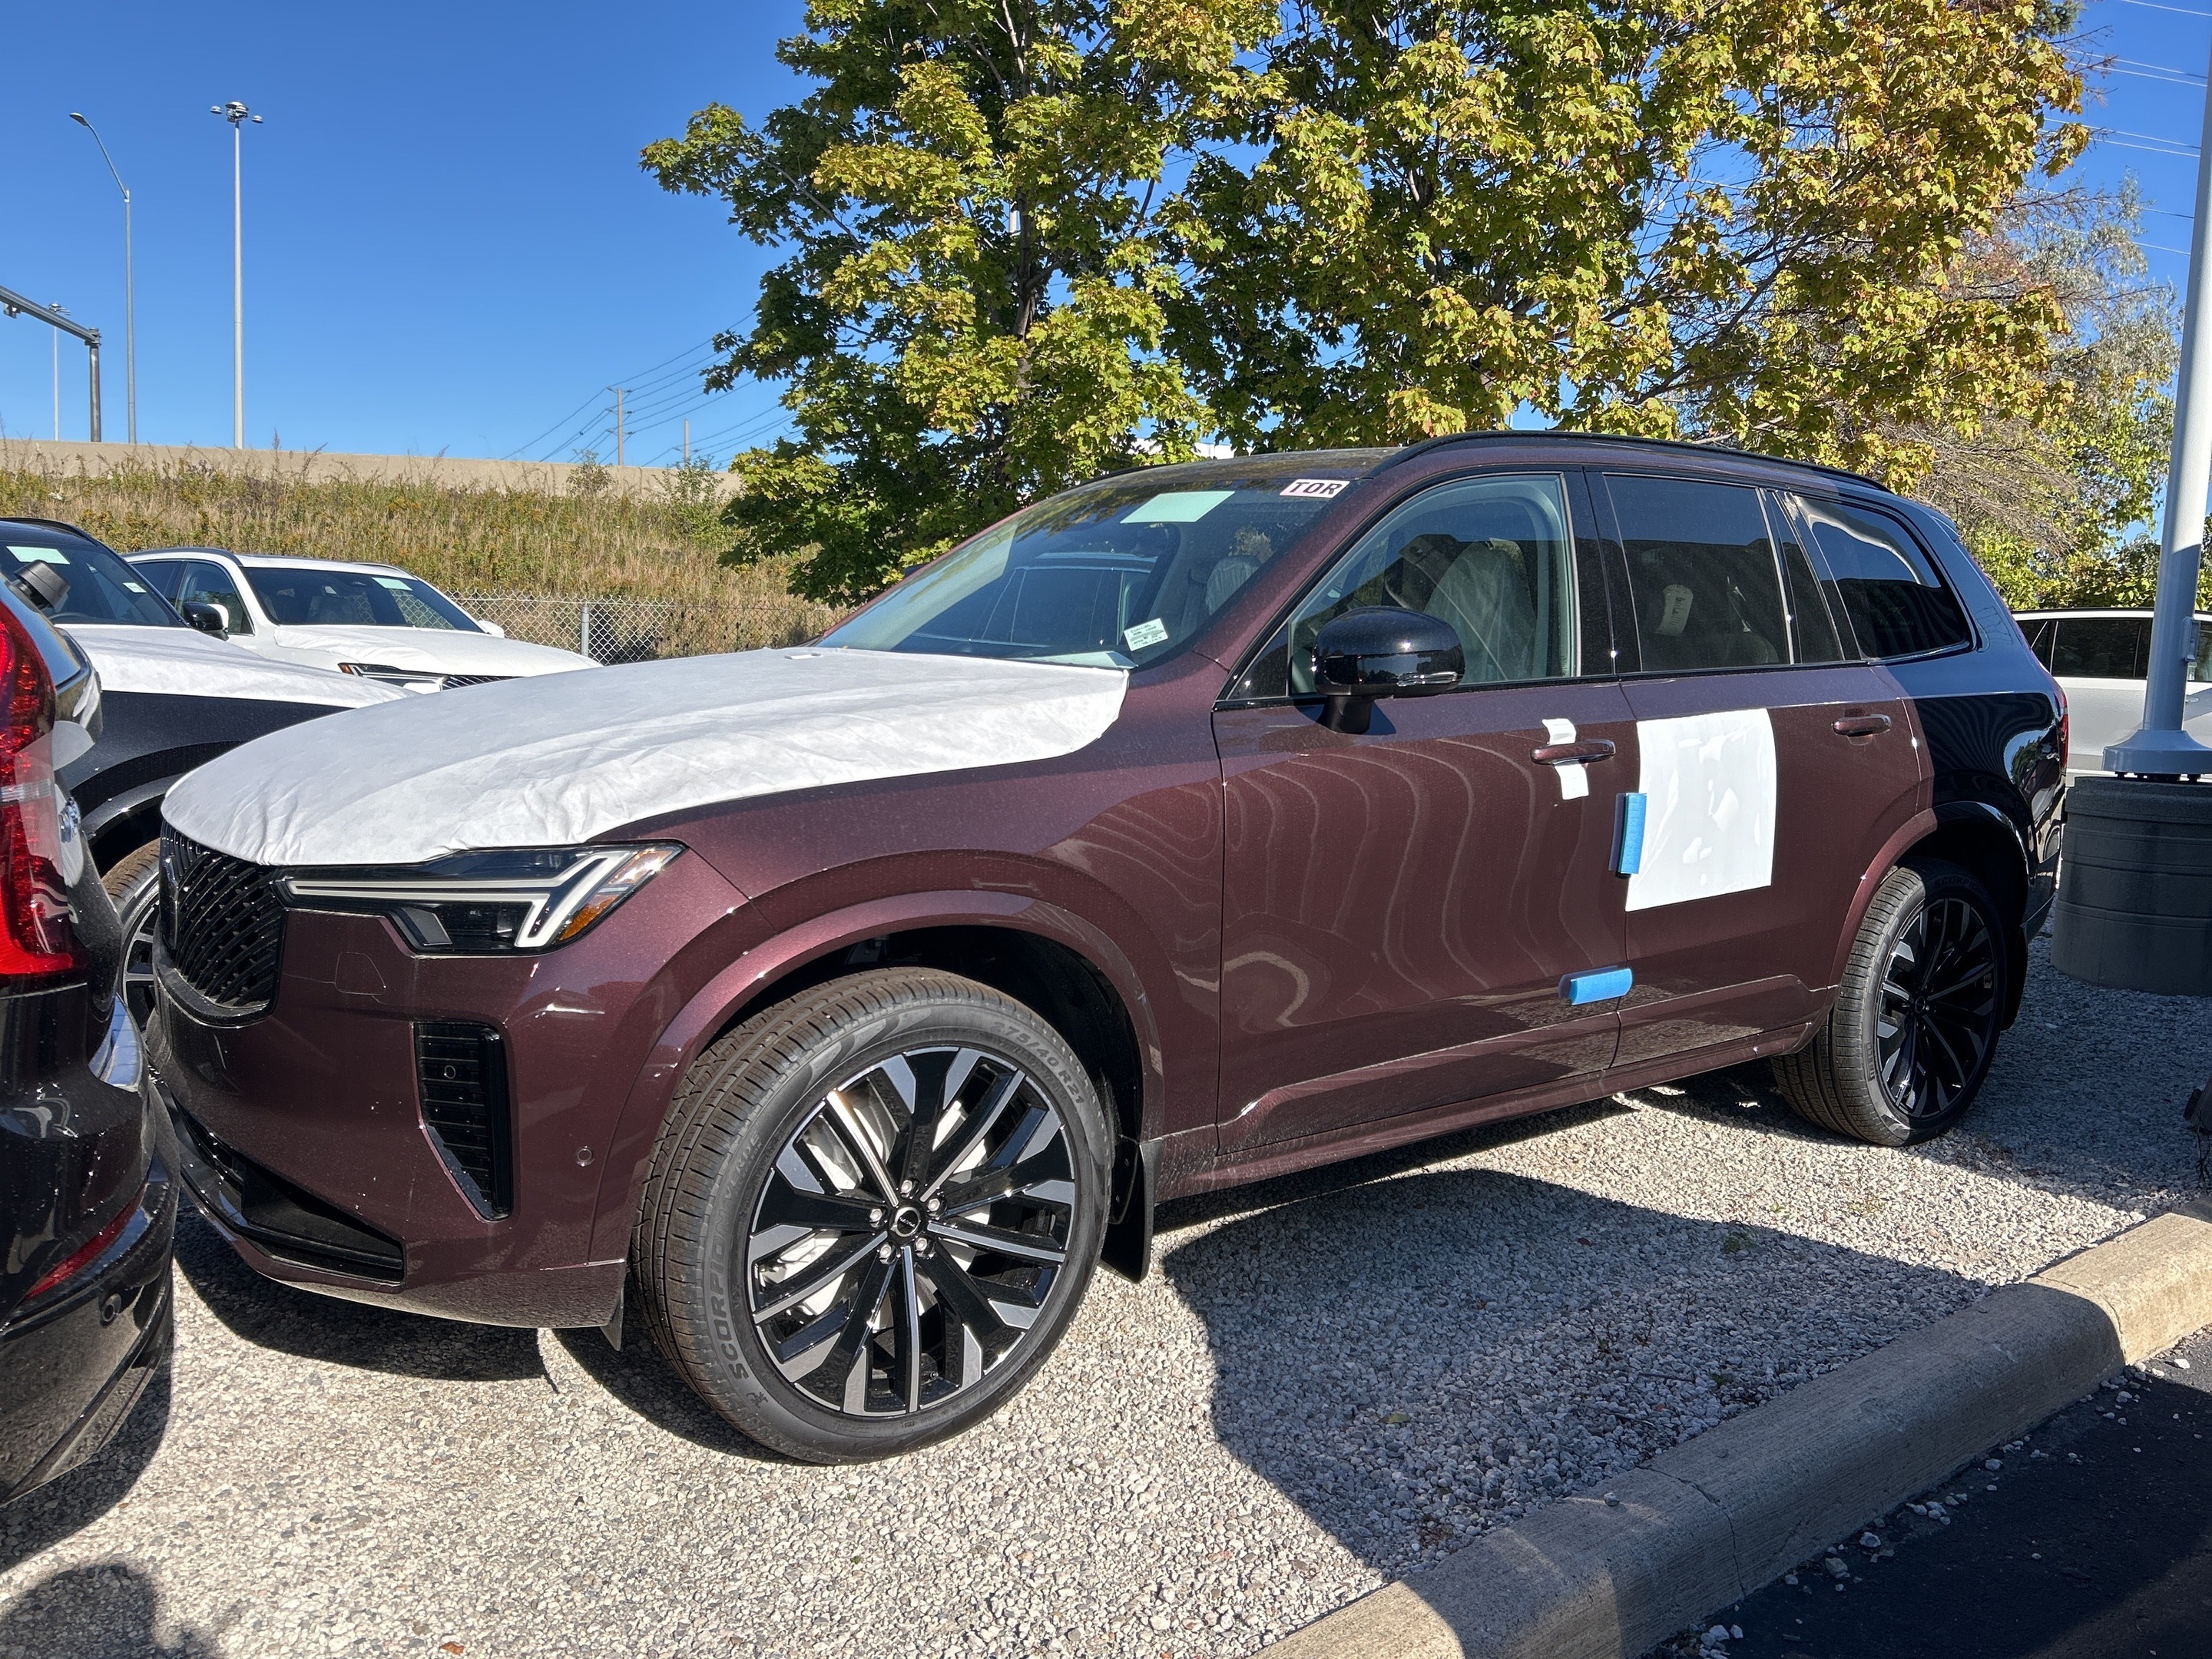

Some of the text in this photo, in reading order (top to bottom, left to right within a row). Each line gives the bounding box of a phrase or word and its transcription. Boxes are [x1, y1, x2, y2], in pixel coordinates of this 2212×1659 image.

[1290, 482, 1343, 495] TOR
[989, 1022, 1059, 1067] 275/40
[1058, 1070, 1084, 1104] R21
[710, 1131, 760, 1379] SCORPION VERDE
